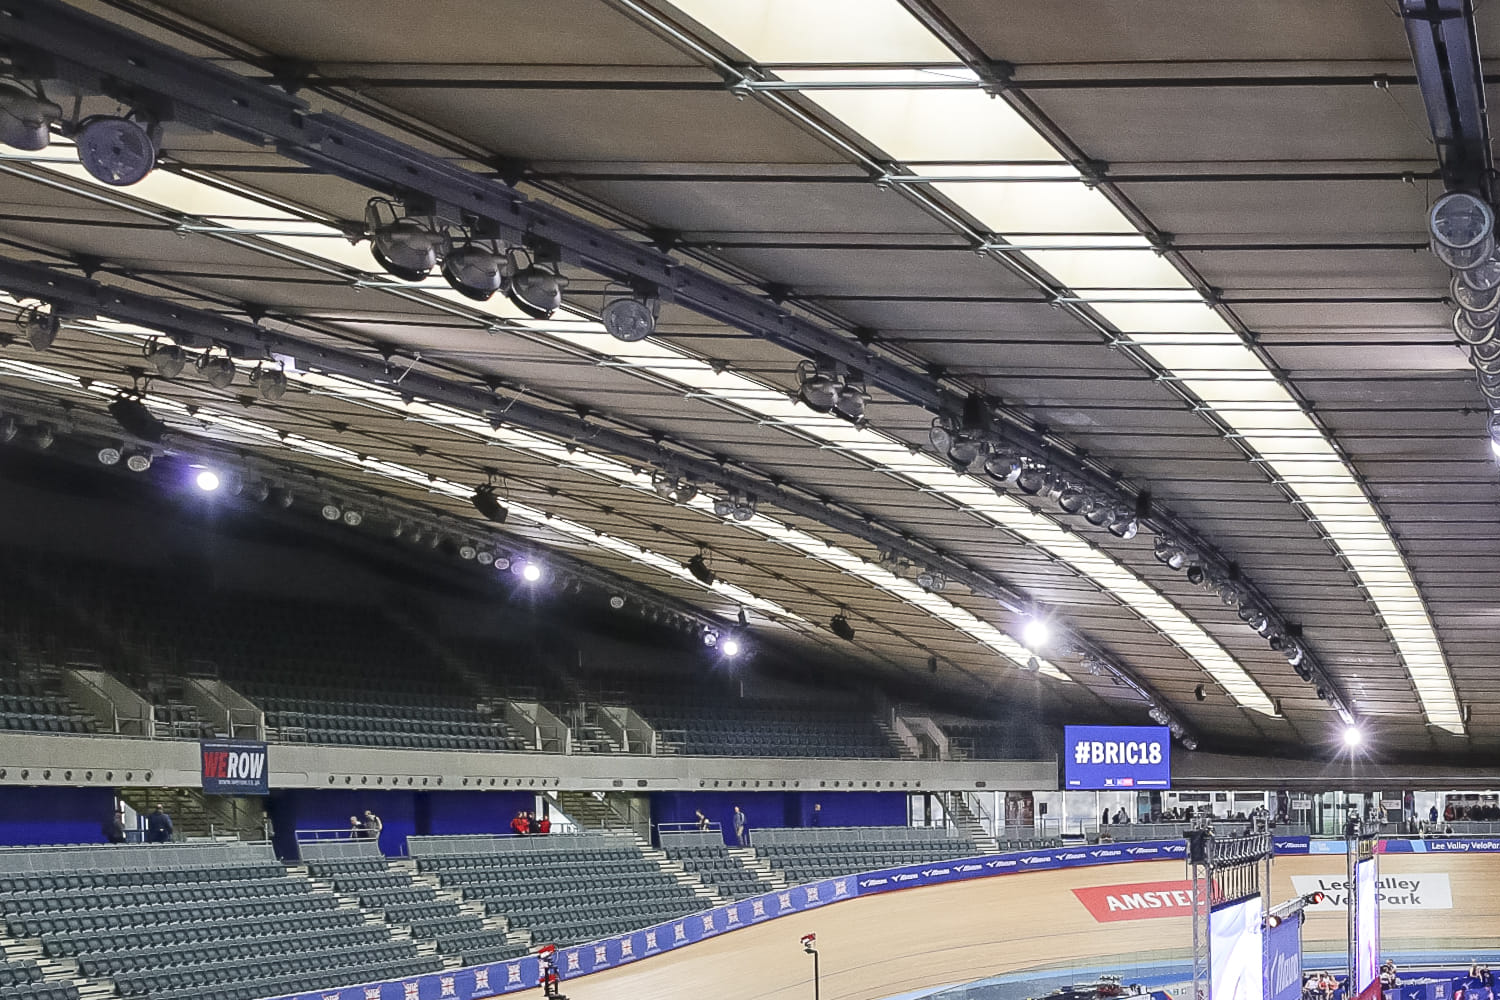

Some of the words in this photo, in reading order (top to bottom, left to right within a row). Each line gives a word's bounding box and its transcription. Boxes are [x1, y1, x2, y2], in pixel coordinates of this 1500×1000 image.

[1074, 741, 1162, 764] #BRIC18
[1431, 842, 1445, 850] Lee
[1447, 841, 1470, 851] Valley
